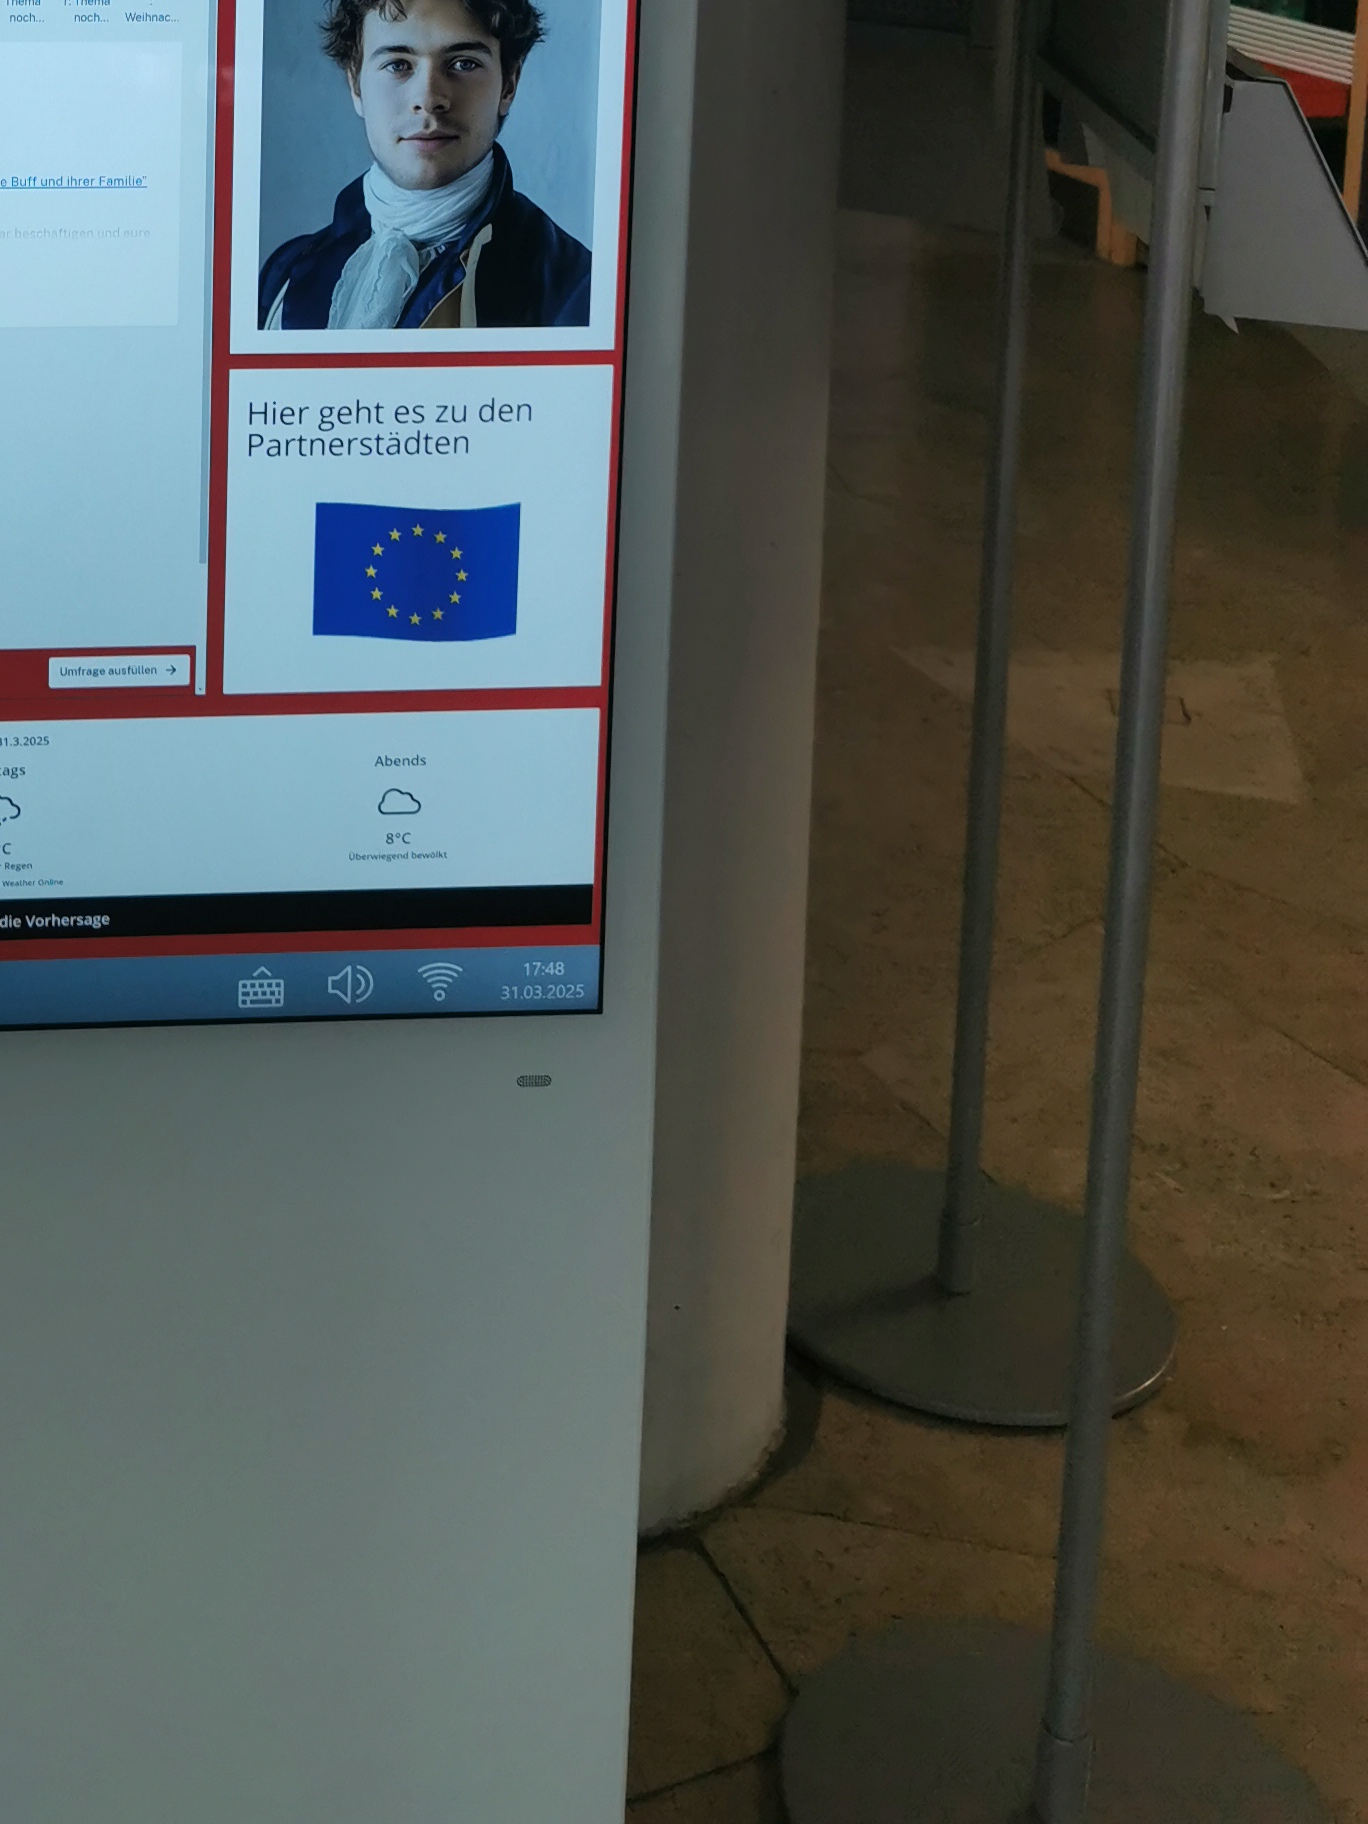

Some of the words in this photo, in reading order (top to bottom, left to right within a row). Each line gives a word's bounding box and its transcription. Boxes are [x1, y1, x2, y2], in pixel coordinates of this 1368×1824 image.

[125, 12, 180, 23] Weihnac...
[248, 400, 310, 426] Hier
[318, 399, 385, 432] geht
[394, 404, 426, 425] es
[435, 403, 467, 425] zu
[478, 397, 533, 423] den
[247, 430, 471, 458] Partnerstädten
[59, 665, 106, 679] Umfrage
[107, 664, 158, 677] ausfüllen
[374, 753, 427, 767] Abends
[385, 832, 412, 845] 8°C
[347, 850, 409, 863] Überwiegend
[410, 850, 448, 860] bewölkt
[4, 860, 33, 873] Regen
[1, 879, 36, 888] Weather
[37, 877, 64, 887] Online
[25, 912, 111, 931] Vorhersage
[523, 961, 565, 977] 17:48
[500, 983, 585, 1000] 31.03.2025
